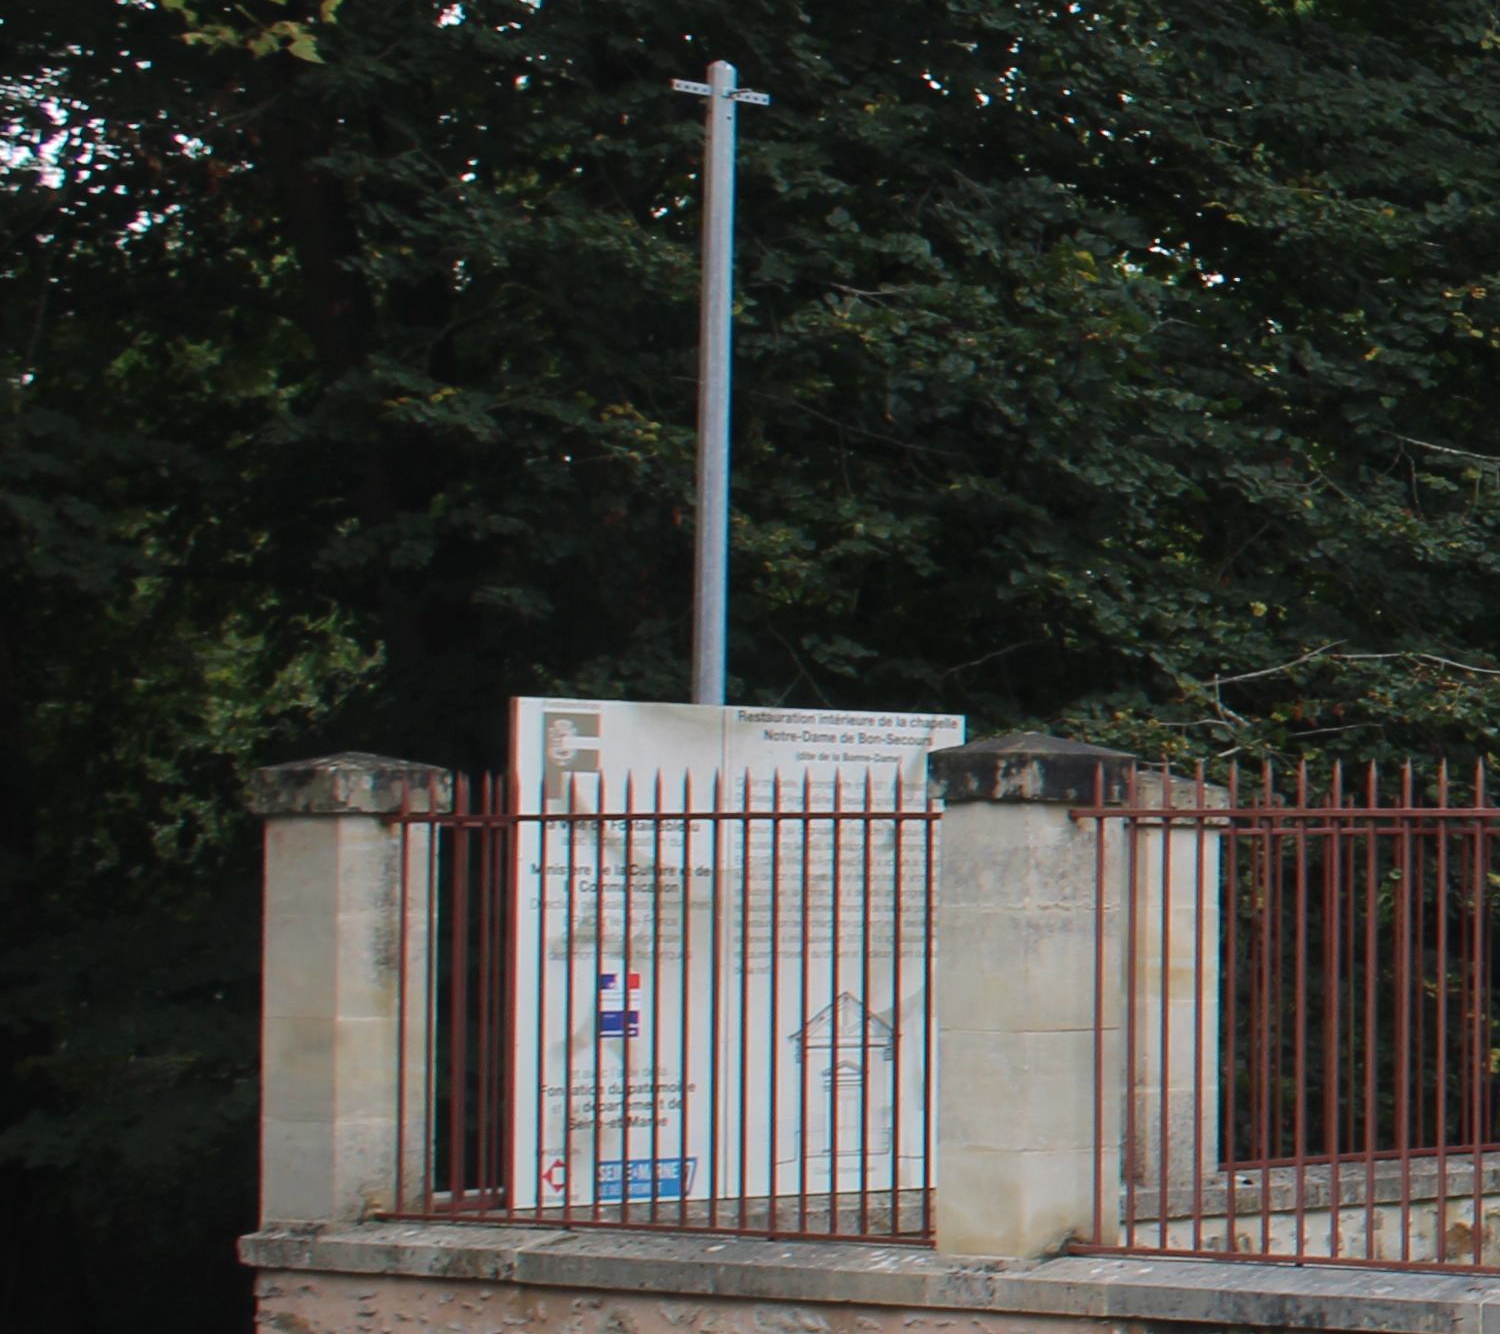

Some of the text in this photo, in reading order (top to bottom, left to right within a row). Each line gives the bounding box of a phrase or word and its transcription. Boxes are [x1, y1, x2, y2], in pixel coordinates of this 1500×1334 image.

[738, 710, 959, 731] Restauration intérieure de la chapelle
[764, 729, 933, 746] Notre-Dame de Bon-Secours
[629, 864, 676, 877] Cultre
[540, 1083, 604, 1097] Fonatio
